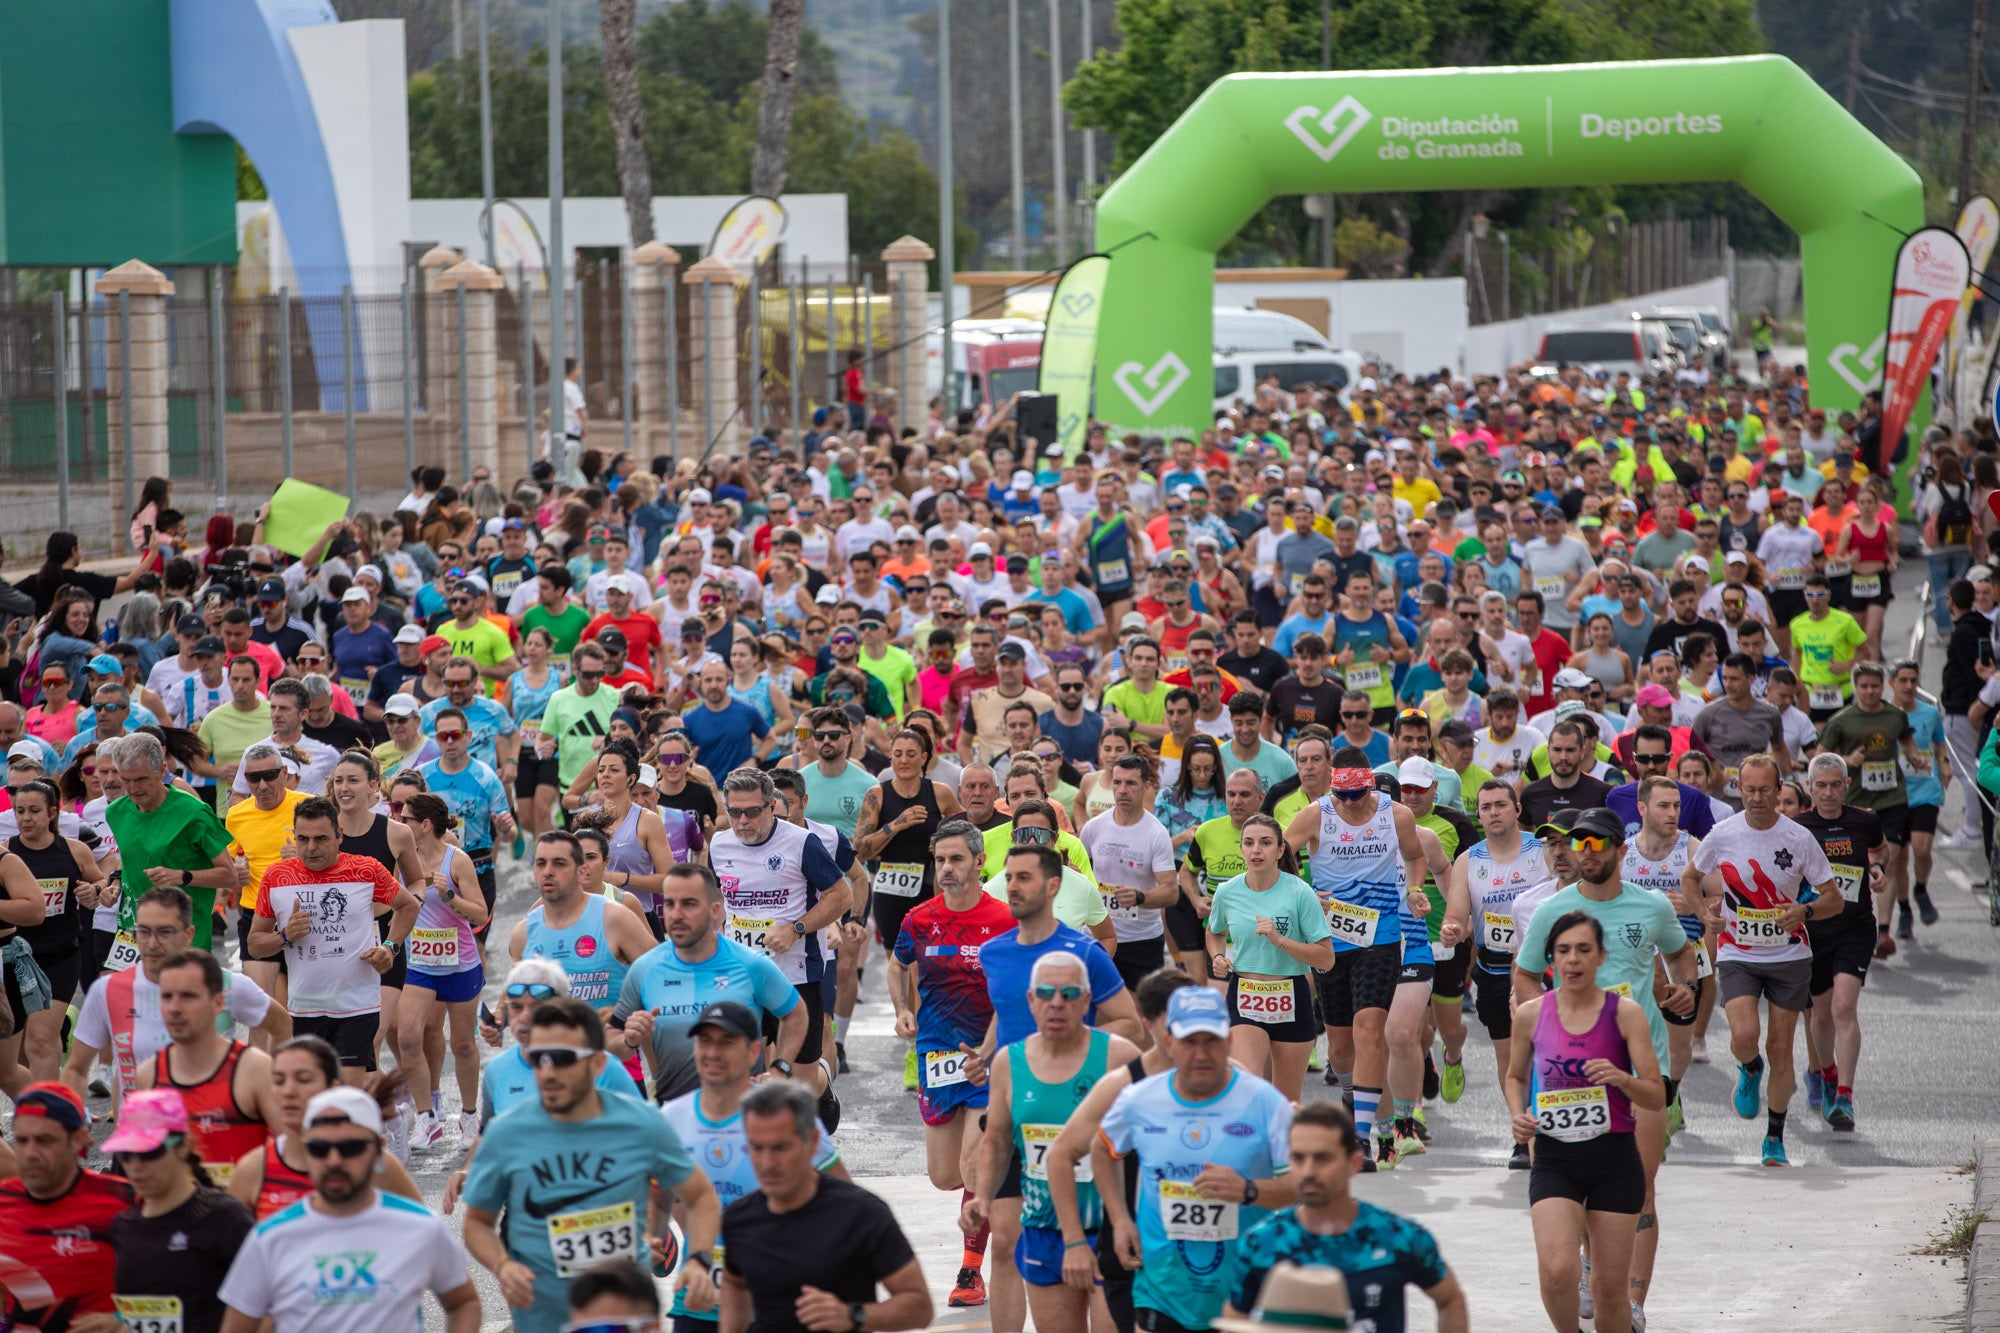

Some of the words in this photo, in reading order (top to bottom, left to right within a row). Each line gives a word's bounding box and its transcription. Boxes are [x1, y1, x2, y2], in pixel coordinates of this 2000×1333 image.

[1381, 113, 1520, 139] Diputación
[1580, 111, 1723, 142] Deportes
[1378, 141, 1411, 161] de
[1415, 138, 1524, 160] Granada
[1868, 770, 1893, 783] 412
[1330, 843, 1388, 856] MARACENA
[1826, 846, 1853, 857] 2025
[876, 872, 921, 889] 3107
[295, 891, 316, 903] XII
[1482, 890, 1527, 905] MARAC
[308, 925, 346, 935] OMANA
[1330, 914, 1367, 937] 554
[411, 940, 456, 957] 2209
[567, 971, 611, 984] MARATÓN
[1239, 994, 1293, 1013] 2268
[1540, 1105, 1607, 1131] 3323
[531, 1151, 616, 1189] NIKE
[1170, 1203, 1226, 1226] 287
[556, 1226, 633, 1261] 3133
